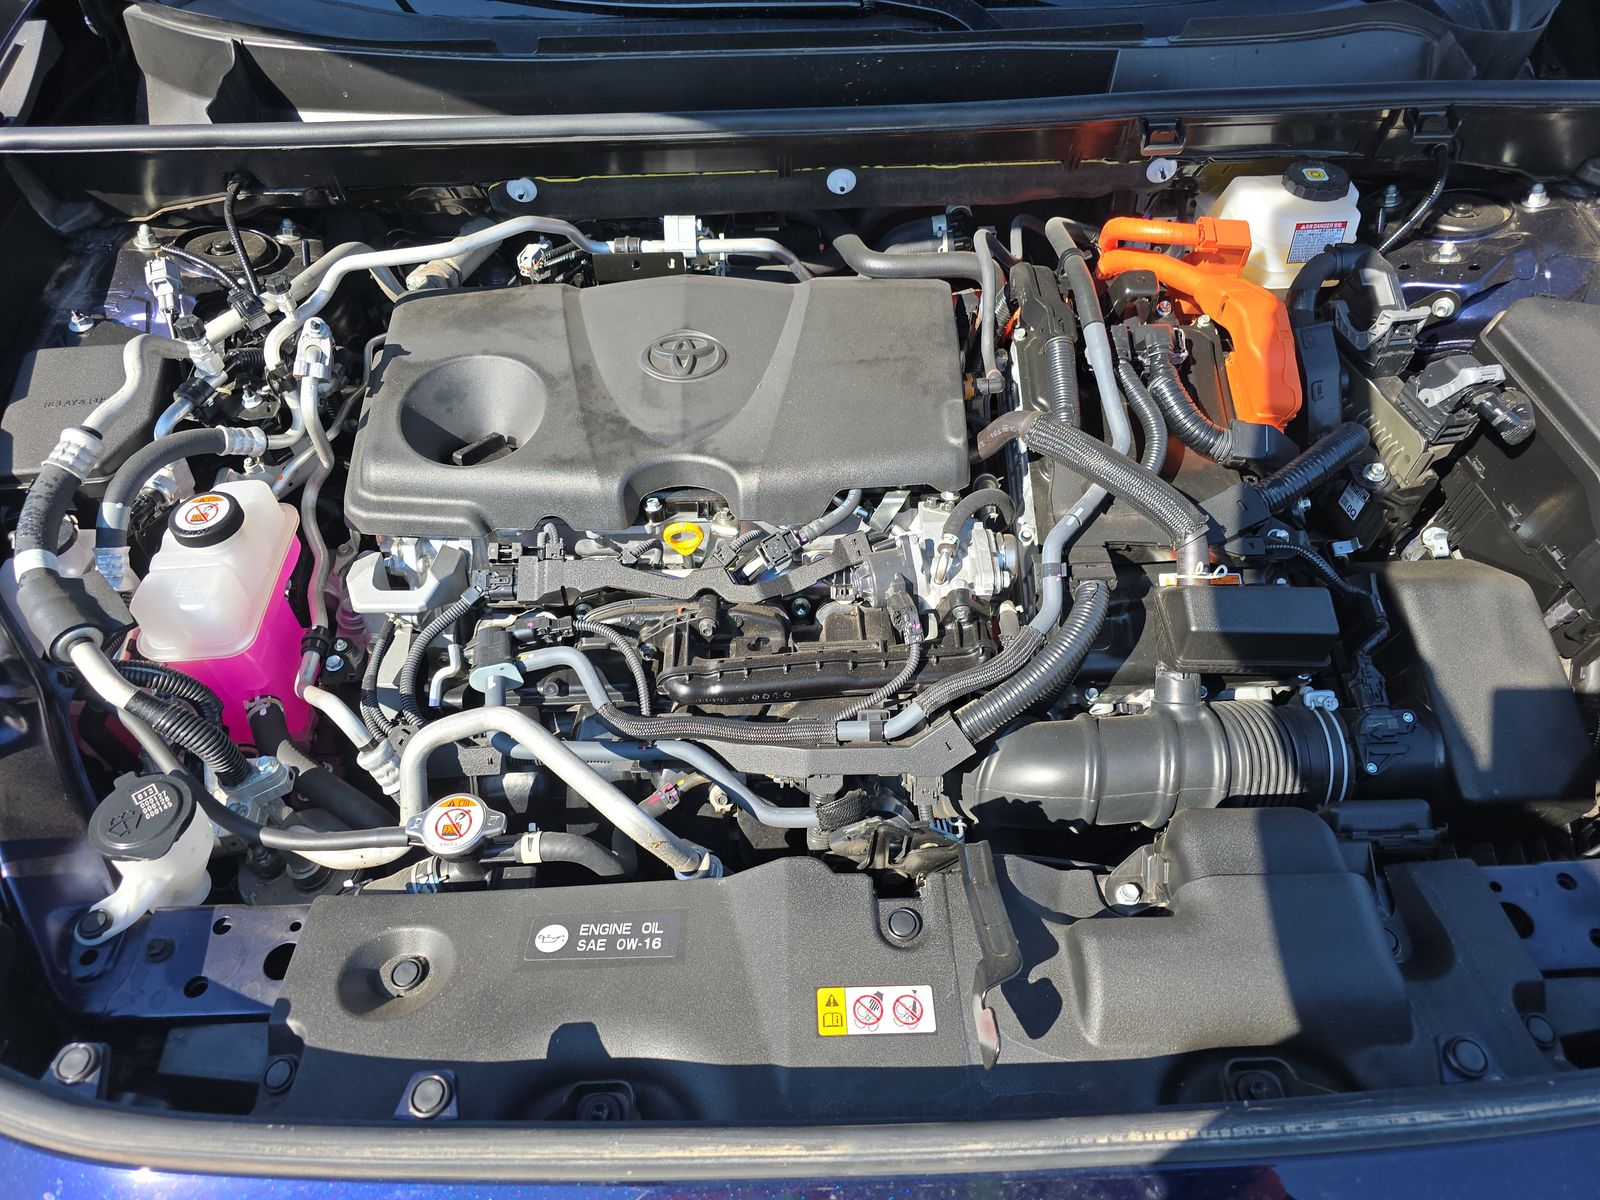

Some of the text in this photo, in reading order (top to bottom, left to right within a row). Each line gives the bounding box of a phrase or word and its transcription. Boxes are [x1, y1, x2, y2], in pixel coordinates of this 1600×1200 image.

[140, 790, 167, 809] 000127
[142, 795, 170, 814] 000128
[145, 801, 173, 820] 000145
[579, 922, 664, 936] ENGINE OIL
[576, 937, 662, 951] SAE 0W-16
